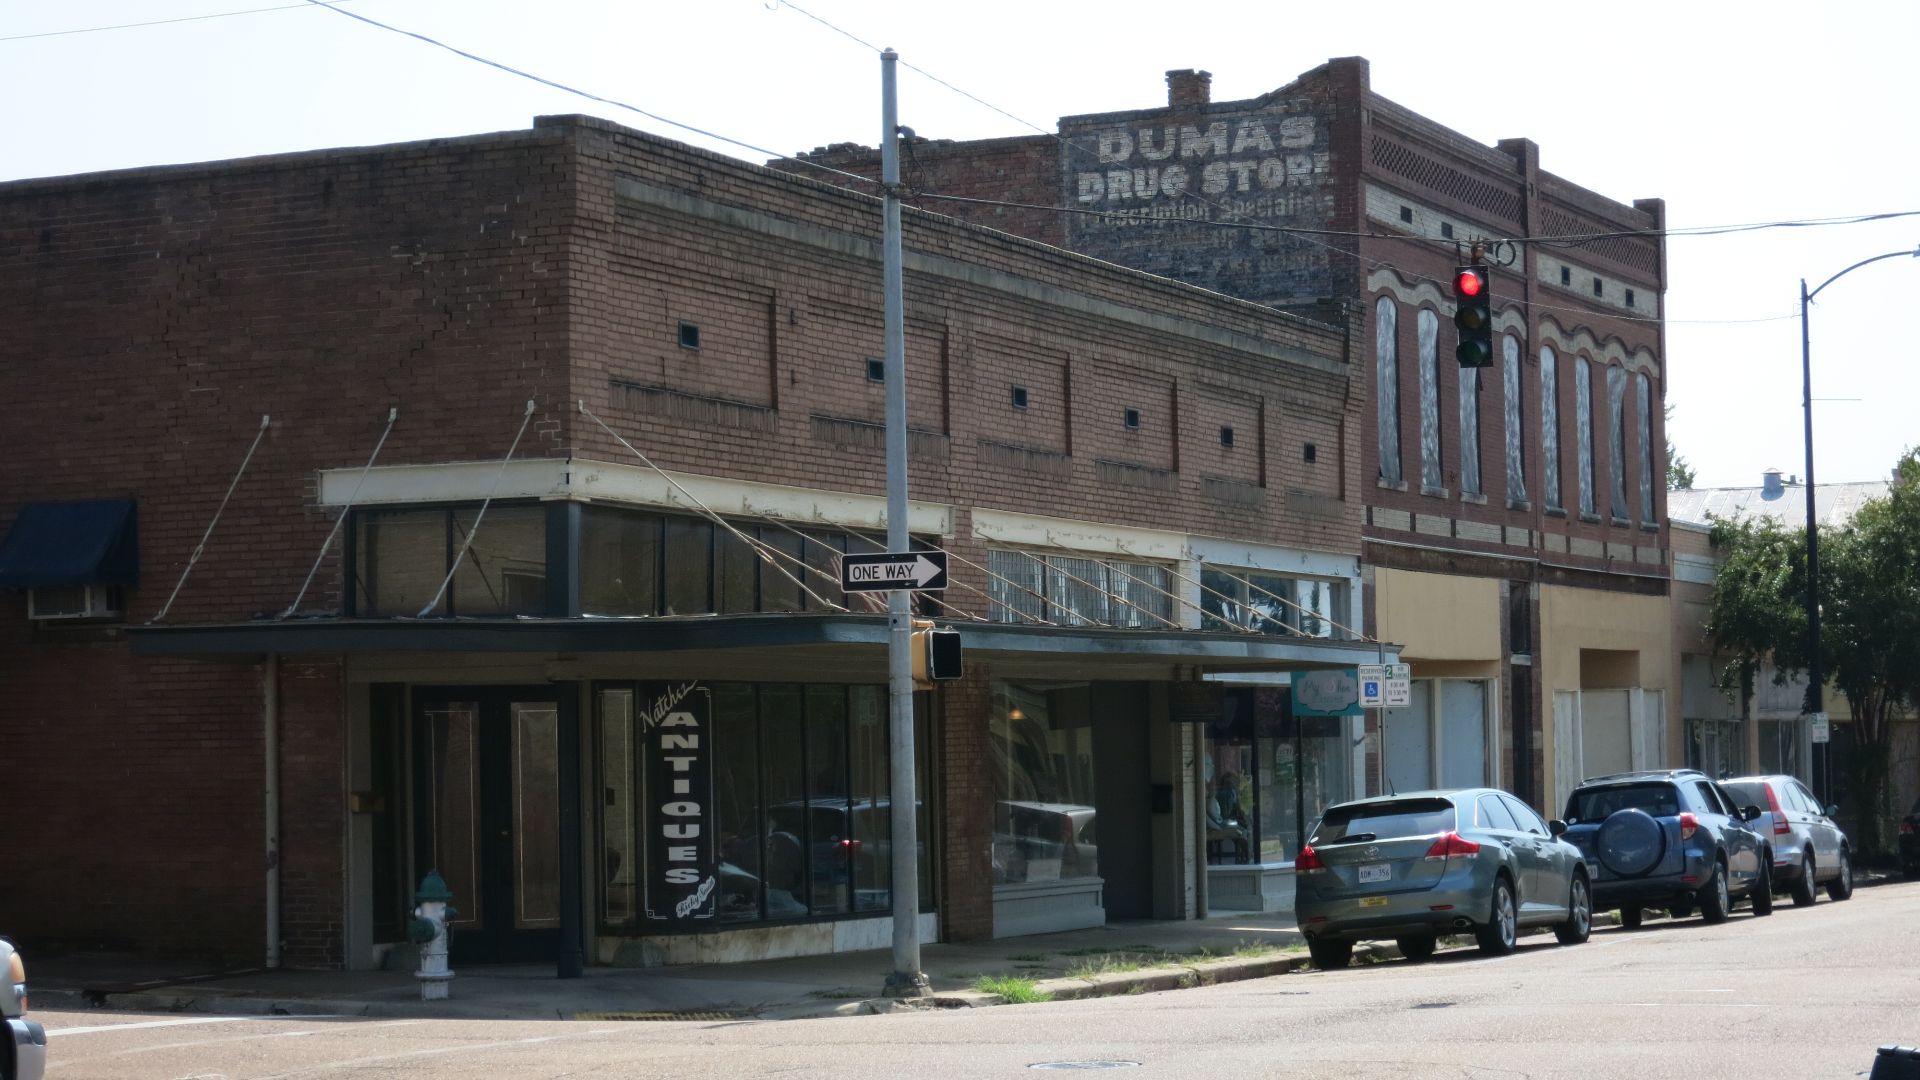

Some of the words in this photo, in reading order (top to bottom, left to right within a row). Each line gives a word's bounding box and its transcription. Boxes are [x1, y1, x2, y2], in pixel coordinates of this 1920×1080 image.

[1099, 115, 1317, 163] DUMAS
[1078, 164, 1189, 202] DRUG
[853, 565, 880, 580] ONE
[885, 564, 915, 579] WAY
[1385, 666, 1392, 678] 2
[640, 680, 698, 733] Natchez
[661, 711, 702, 884] ANTIQUES
